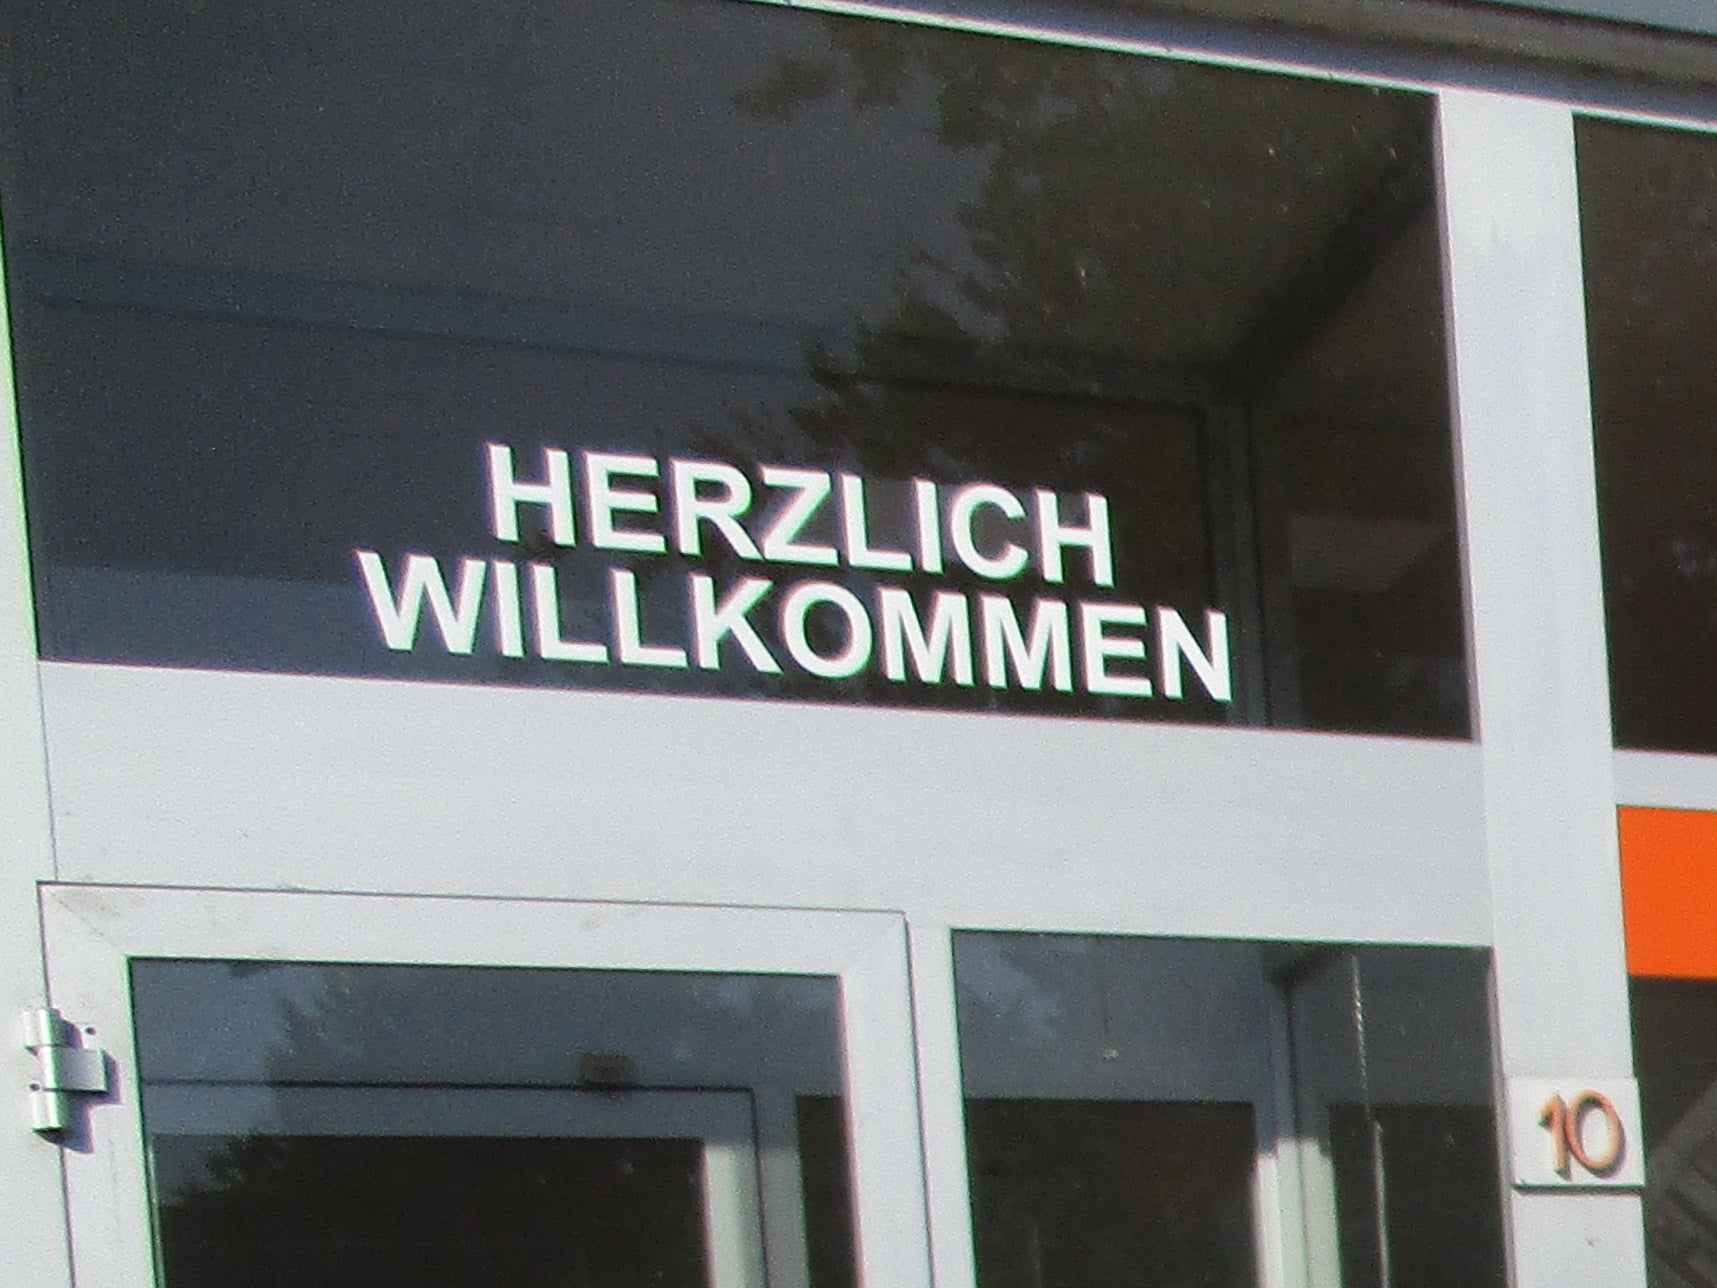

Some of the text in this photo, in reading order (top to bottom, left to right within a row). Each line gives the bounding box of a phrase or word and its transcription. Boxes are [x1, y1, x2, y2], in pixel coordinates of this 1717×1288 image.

[487, 442, 1115, 588] HERZLICH
[358, 550, 1233, 703] WILLKOMMEN
[1538, 1090, 1624, 1176] 10
